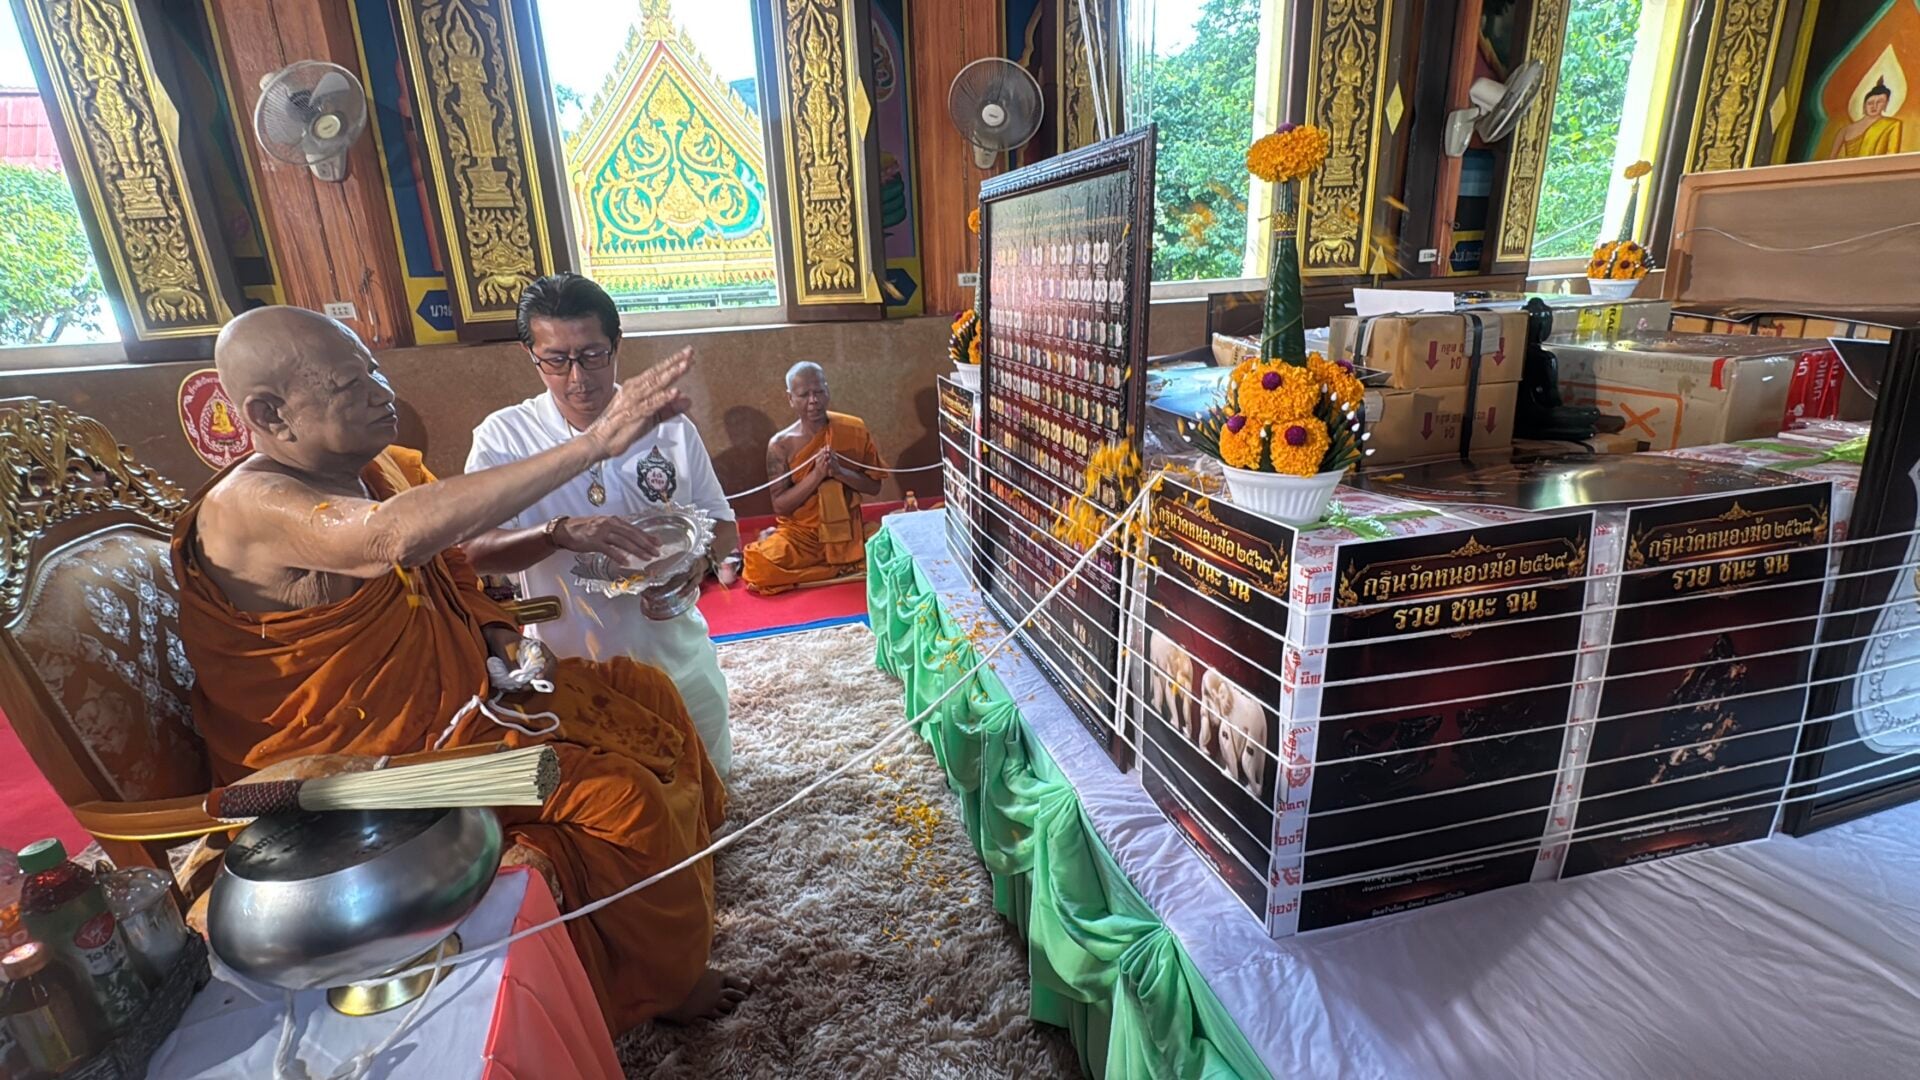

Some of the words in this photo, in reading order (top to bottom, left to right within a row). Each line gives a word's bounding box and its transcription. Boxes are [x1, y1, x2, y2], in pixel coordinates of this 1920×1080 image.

[1362, 552, 1517, 600] กฐินวัดหนองฆ้อ
[1672, 564, 1711, 590] รวย
[1719, 559, 1757, 581] ชนะ
[1763, 553, 1790, 574] จน
[1392, 603, 1441, 630] รวย
[1451, 597, 1497, 622] ชนะ
[1506, 589, 1538, 613] จน
